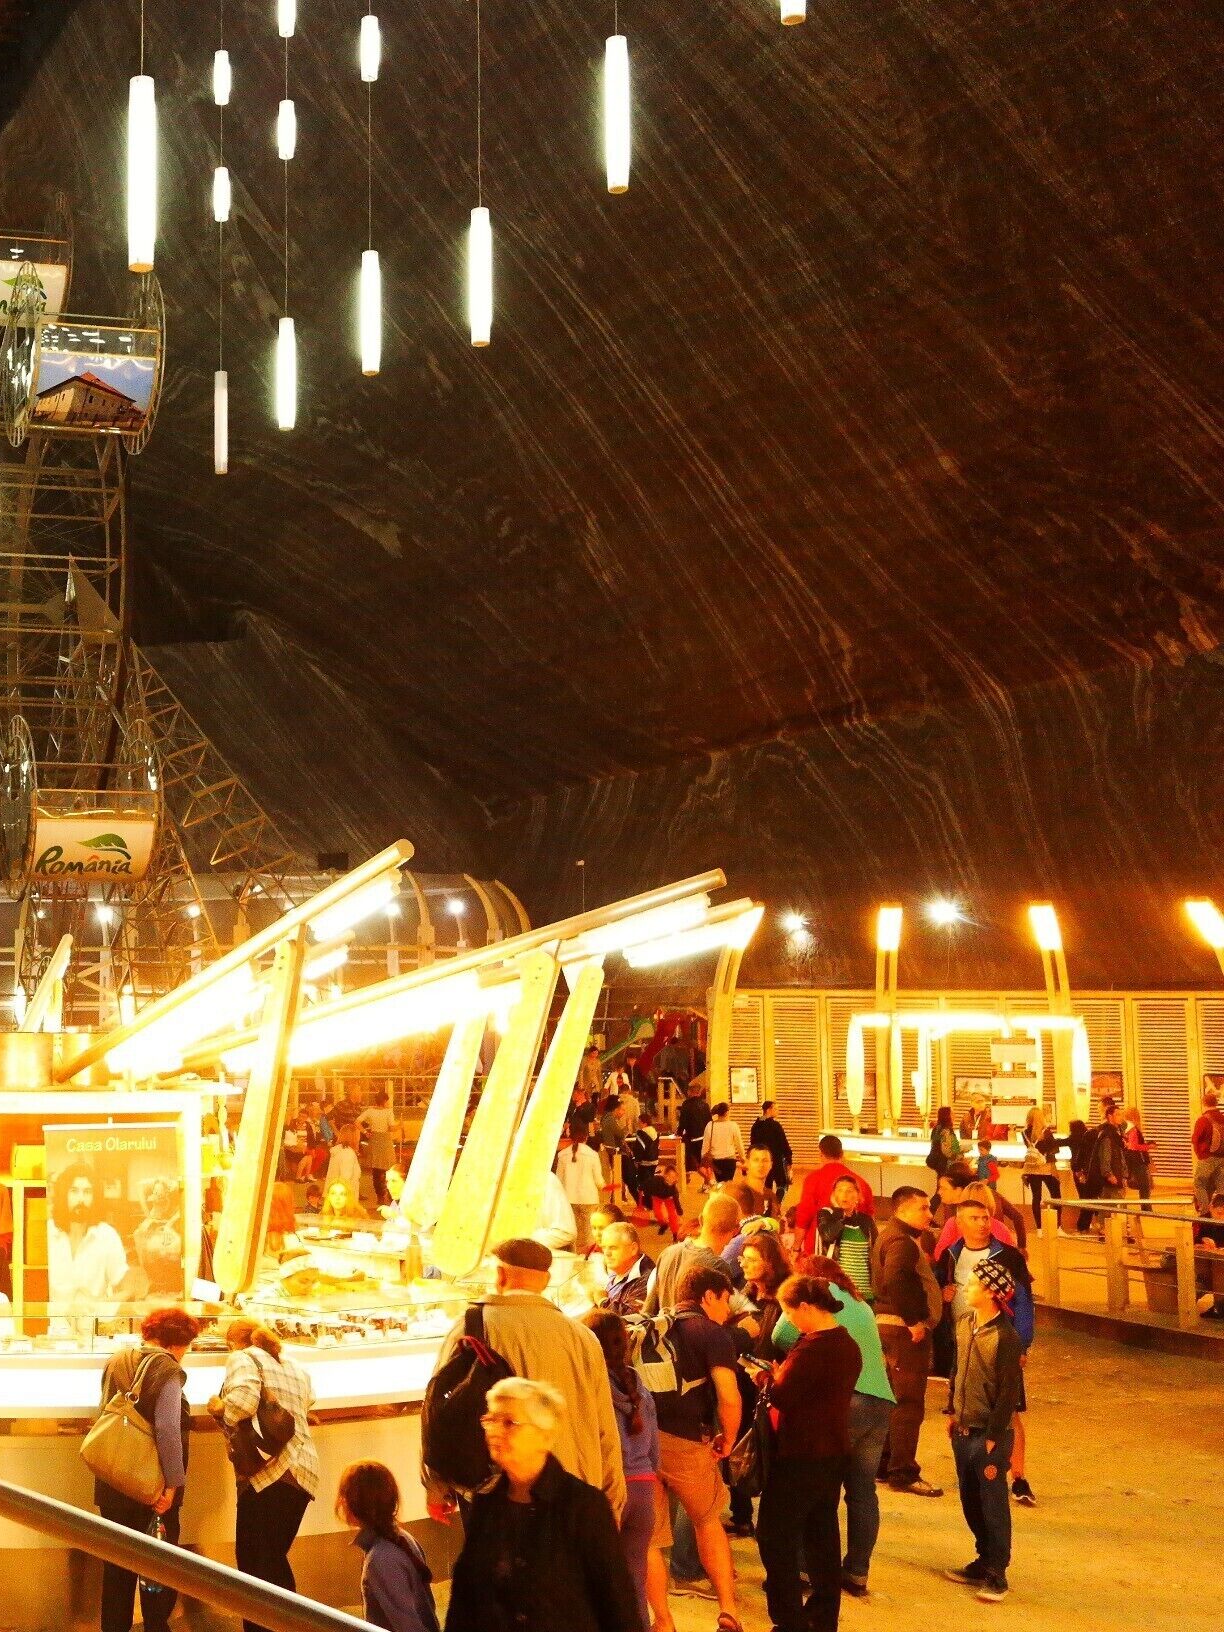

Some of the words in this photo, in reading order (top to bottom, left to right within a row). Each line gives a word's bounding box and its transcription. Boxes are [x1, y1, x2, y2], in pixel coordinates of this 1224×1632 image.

[35, 845, 132, 876] România
[66, 1138, 103, 1152] Casa
[105, 1136, 157, 1151] Olarului
